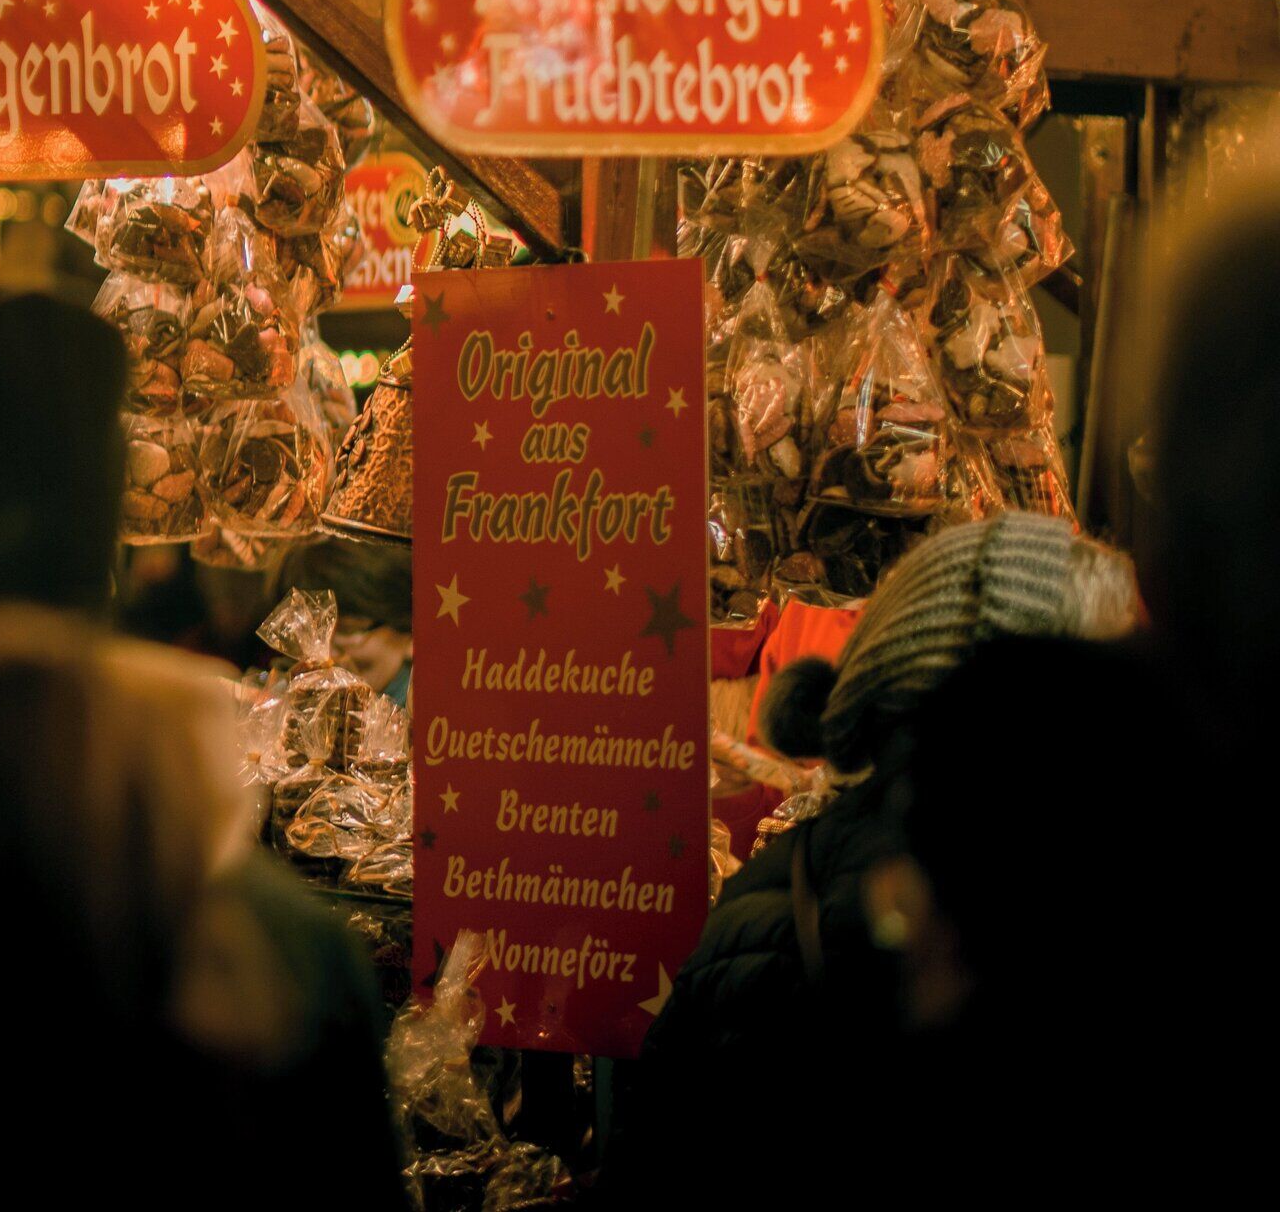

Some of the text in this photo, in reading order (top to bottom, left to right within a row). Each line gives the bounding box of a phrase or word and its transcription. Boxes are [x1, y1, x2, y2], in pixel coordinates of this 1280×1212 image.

[458, 322, 656, 418] Original
[521, 421, 591, 464] aus
[442, 468, 675, 562] Frankfort
[461, 647, 654, 697] Haddekuche
[425, 716, 696, 771] Quetschemännche
[496, 788, 619, 837] Brenten
[443, 855, 675, 914] Bethmännchen
[486, 928, 637, 989] Nonneförz
